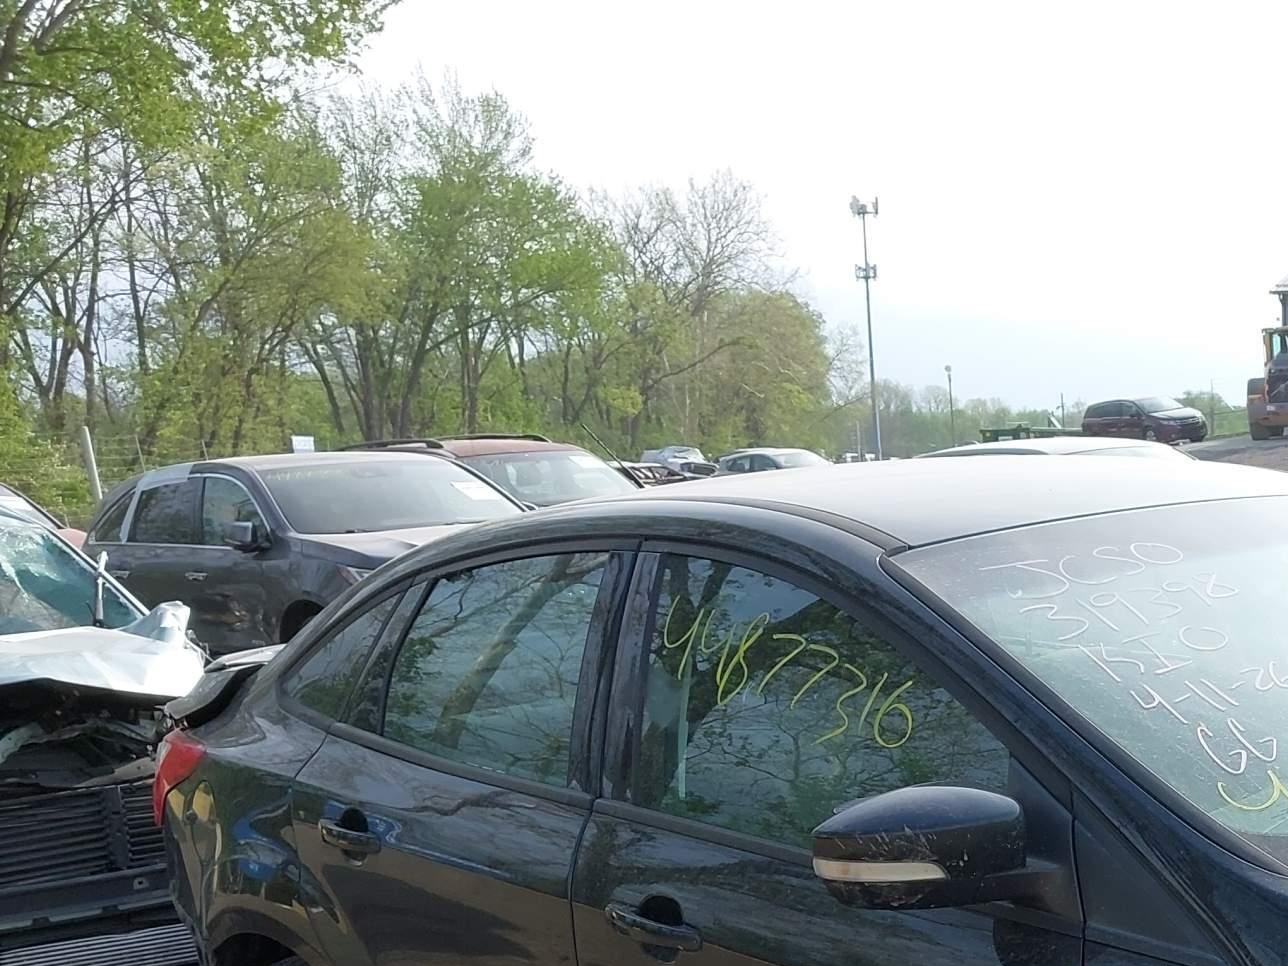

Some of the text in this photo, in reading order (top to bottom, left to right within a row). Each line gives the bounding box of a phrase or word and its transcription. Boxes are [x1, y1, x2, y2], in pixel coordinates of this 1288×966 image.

[979, 542, 1184, 599] JCSO
[1019, 572, 1241, 640] 319398
[664, 594, 914, 748] 44877316
